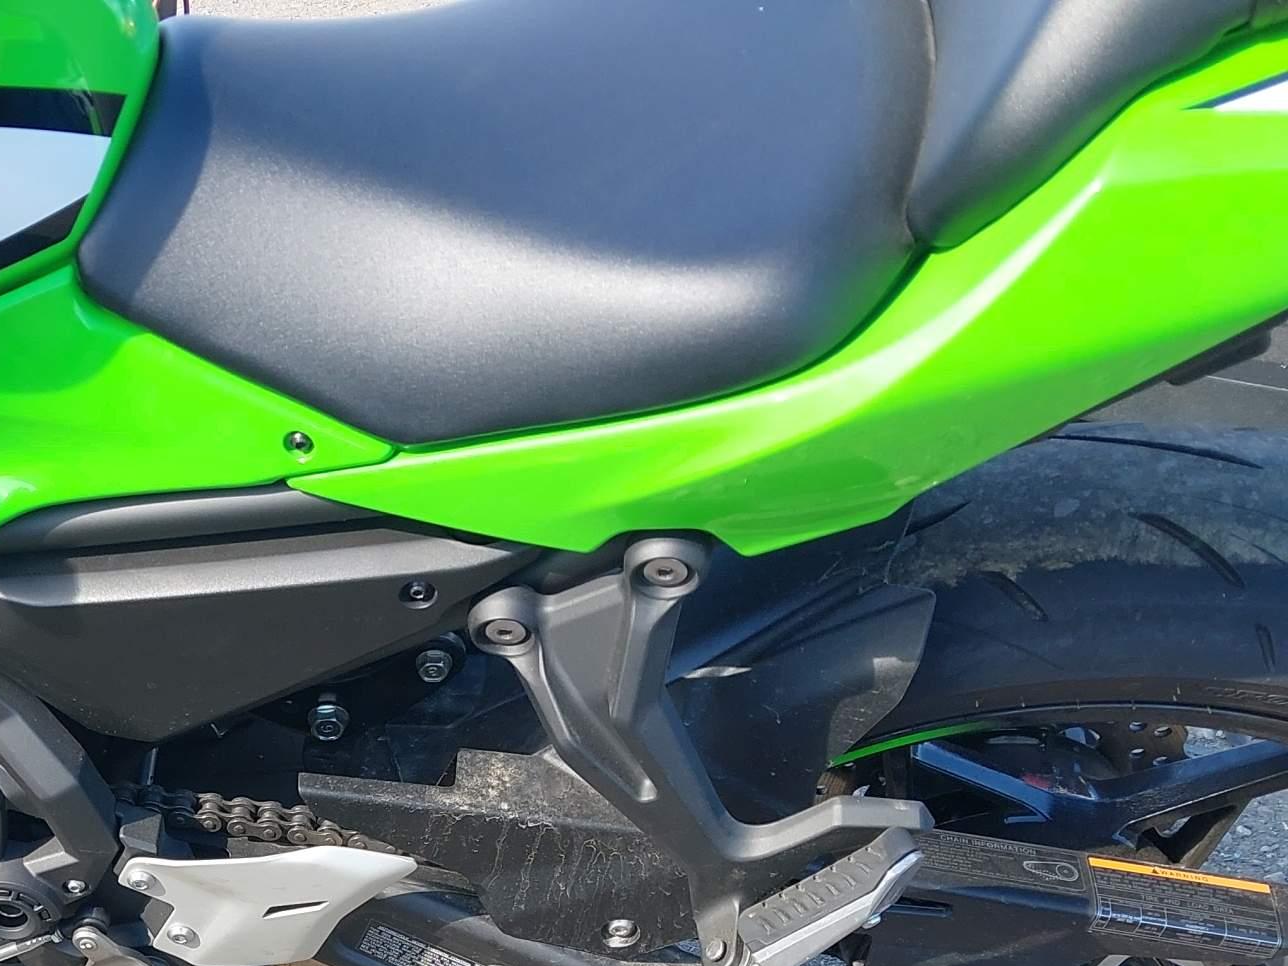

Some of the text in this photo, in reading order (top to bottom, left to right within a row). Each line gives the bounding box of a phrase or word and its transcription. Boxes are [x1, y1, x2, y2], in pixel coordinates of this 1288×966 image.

[939, 834, 1037, 856] CHAIN INFORMATION
[1160, 869, 1209, 882] WARNING
